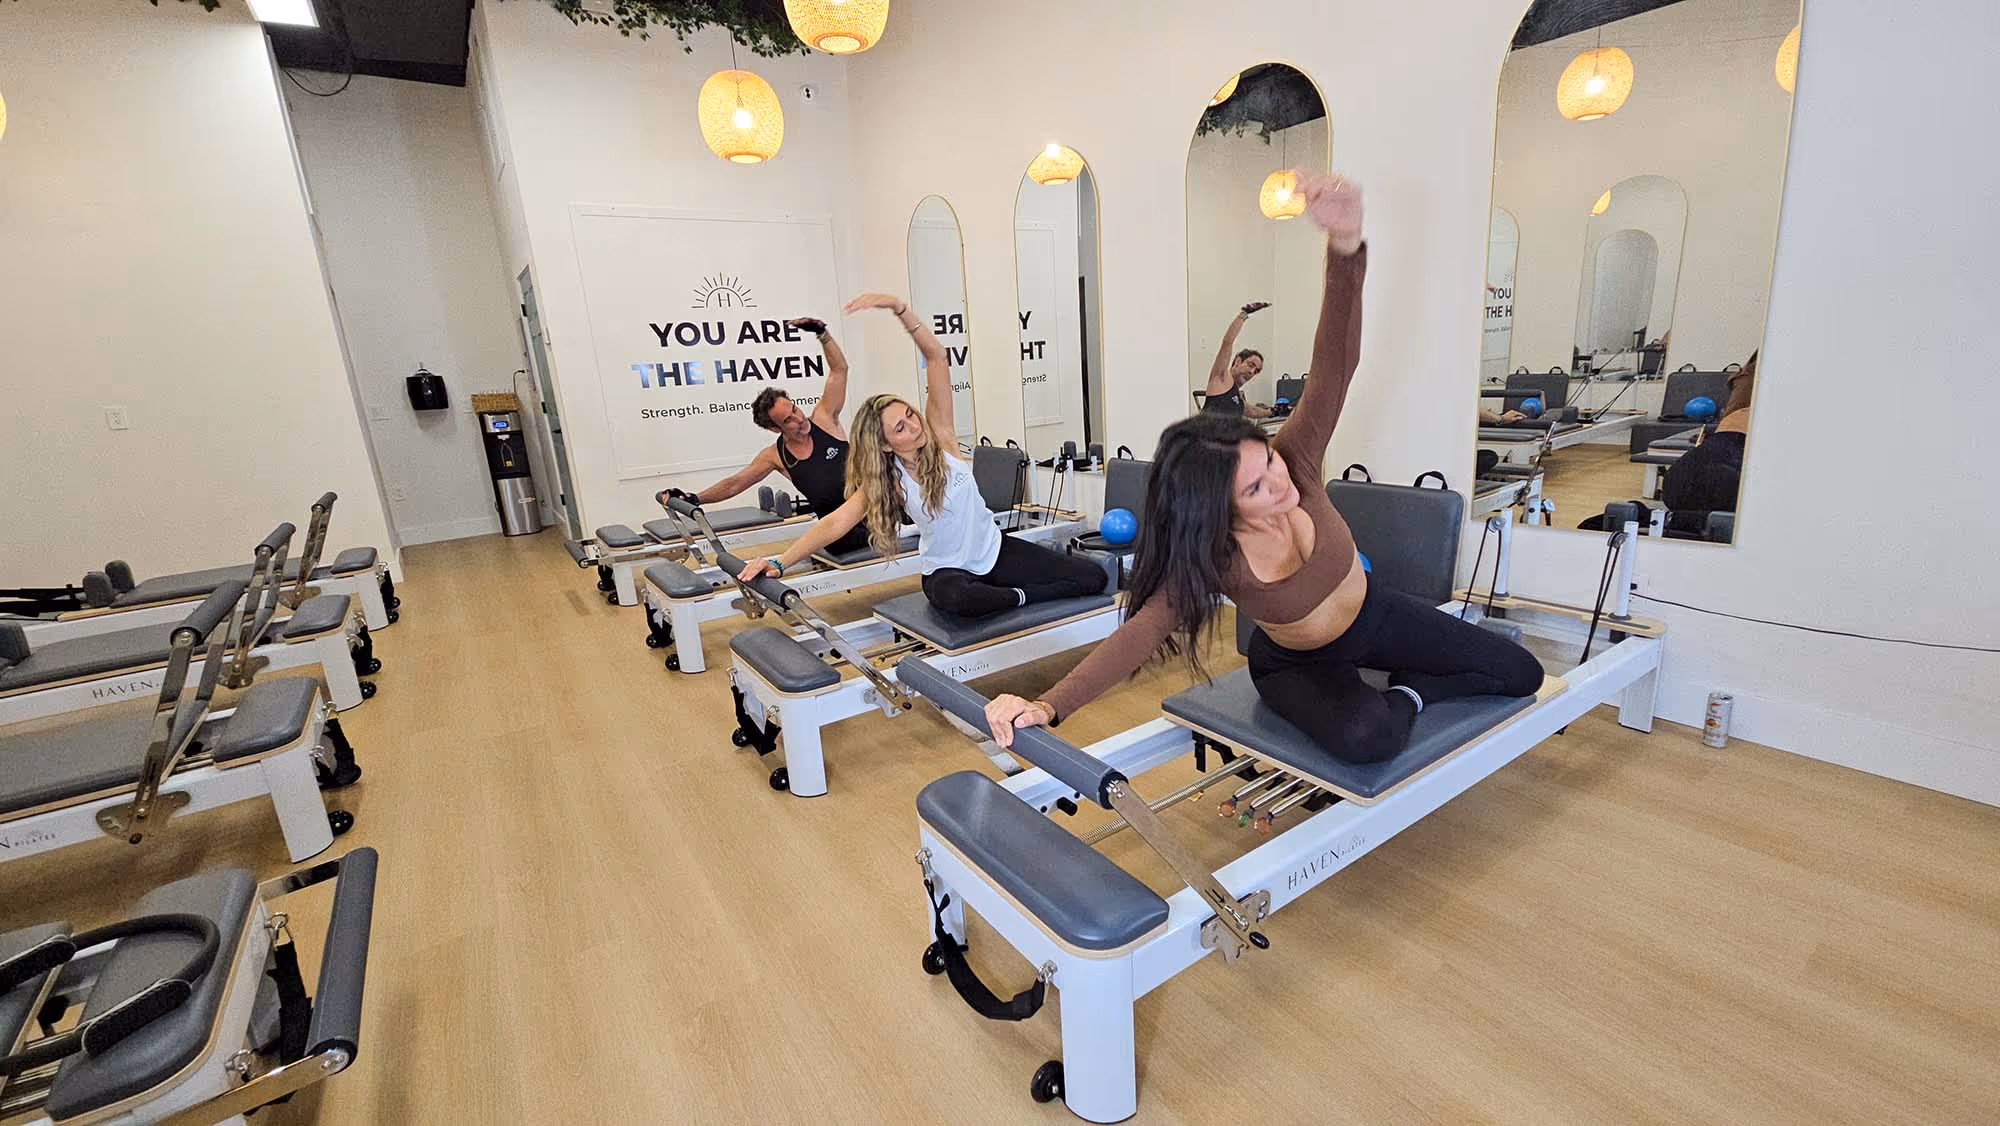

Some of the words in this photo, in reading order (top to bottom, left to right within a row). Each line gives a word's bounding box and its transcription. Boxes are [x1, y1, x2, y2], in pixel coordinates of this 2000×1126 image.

[717, 292, 731, 308] H
[1485, 305, 1503, 319] THE
[648, 321, 726, 348] YOU
[736, 319, 802, 345] ARE
[631, 359, 705, 389] THE
[714, 354, 825, 384] HAVEN
[640, 404, 704, 419] Strength.
[709, 401, 752, 414] Balanc
[92, 679, 154, 699] HAVEN
[1287, 844, 1341, 890] HAVEN
